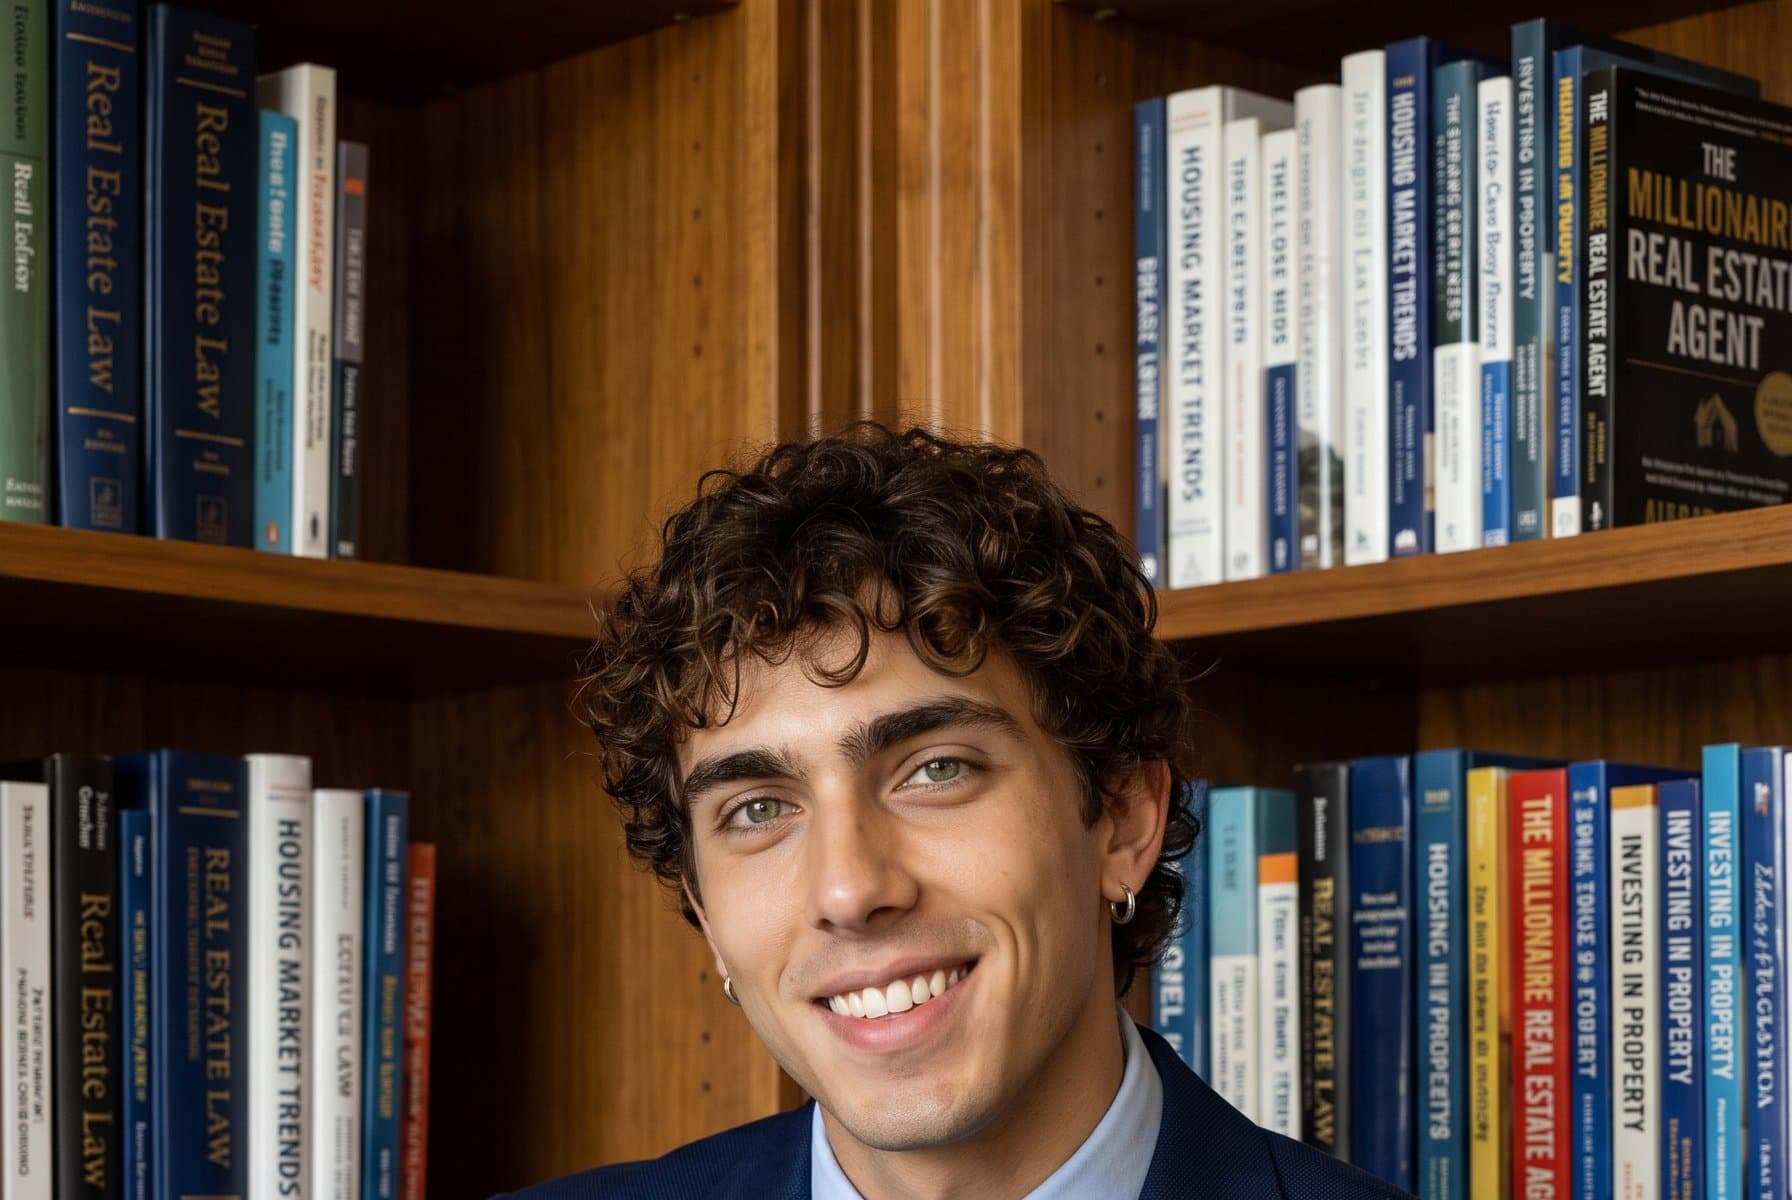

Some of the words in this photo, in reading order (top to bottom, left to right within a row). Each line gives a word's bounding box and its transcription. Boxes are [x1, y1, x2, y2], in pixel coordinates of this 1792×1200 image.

[88, 61, 123, 155] Real
[197, 103, 231, 192] Real
[1392, 92, 1416, 186] HOUSING
[1518, 57, 1535, 163] INVESTING
[1589, 90, 1607, 124] THE
[1519, 168, 1534, 191] IN
[1588, 126, 1607, 231] MILLIONAIRE
[1701, 142, 1737, 181] THE
[87, 165, 121, 294] Estate
[1182, 146, 1203, 271] HOUSING
[1393, 188, 1416, 275] MARKET
[1628, 166, 1792, 252] MILLIONAIR
[196, 203, 228, 325] Estate
[1588, 233, 1607, 276] REAL
[1628, 227, 1700, 294] REAL
[88, 305, 121, 392] Law
[1183, 280, 1203, 386] MARKET
[1393, 277, 1417, 361] TRENDS
[1588, 278, 1606, 340] ESTATE
[1667, 298, 1764, 371] AGENT
[195, 336, 227, 419] Law
[1587, 343, 1606, 397] AGENT
[1183, 397, 1204, 502] TRENDS
[1523, 794, 1553, 843] THE
[205, 847, 231, 940] REAL
[278, 819, 303, 950] HOUSING
[1429, 842, 1449, 957] HOUSING
[1621, 835, 1644, 964] INVESTING
[1667, 809, 1692, 931] INVESTING
[1709, 810, 1732, 927] INVESTING
[82, 892, 113, 973] Real
[1312, 876, 1335, 954] REAL
[1523, 848, 1554, 1003] MILLIONAIRE
[1667, 937, 1692, 962] IN
[1709, 934, 1733, 959] IN
[206, 949, 231, 1080] ESTATE
[278, 959, 303, 1077] MARKET
[1313, 961, 1335, 1071] ESTATE
[1621, 972, 1644, 999] IN
[1668, 966, 1693, 1085] PROPERTY
[1710, 963, 1734, 1081] PROPERTY
[82, 986, 113, 1100] Estate
[1525, 1008, 1555, 1070] REAL
[1622, 1006, 1645, 1134] PROPERTY
[82, 1109, 113, 1189] Law
[206, 1089, 231, 1168] LAW
[278, 1085, 302, 1198] TRENDS
[1314, 1079, 1335, 1145] LAW
[1525, 1074, 1555, 1160] ESTATE
